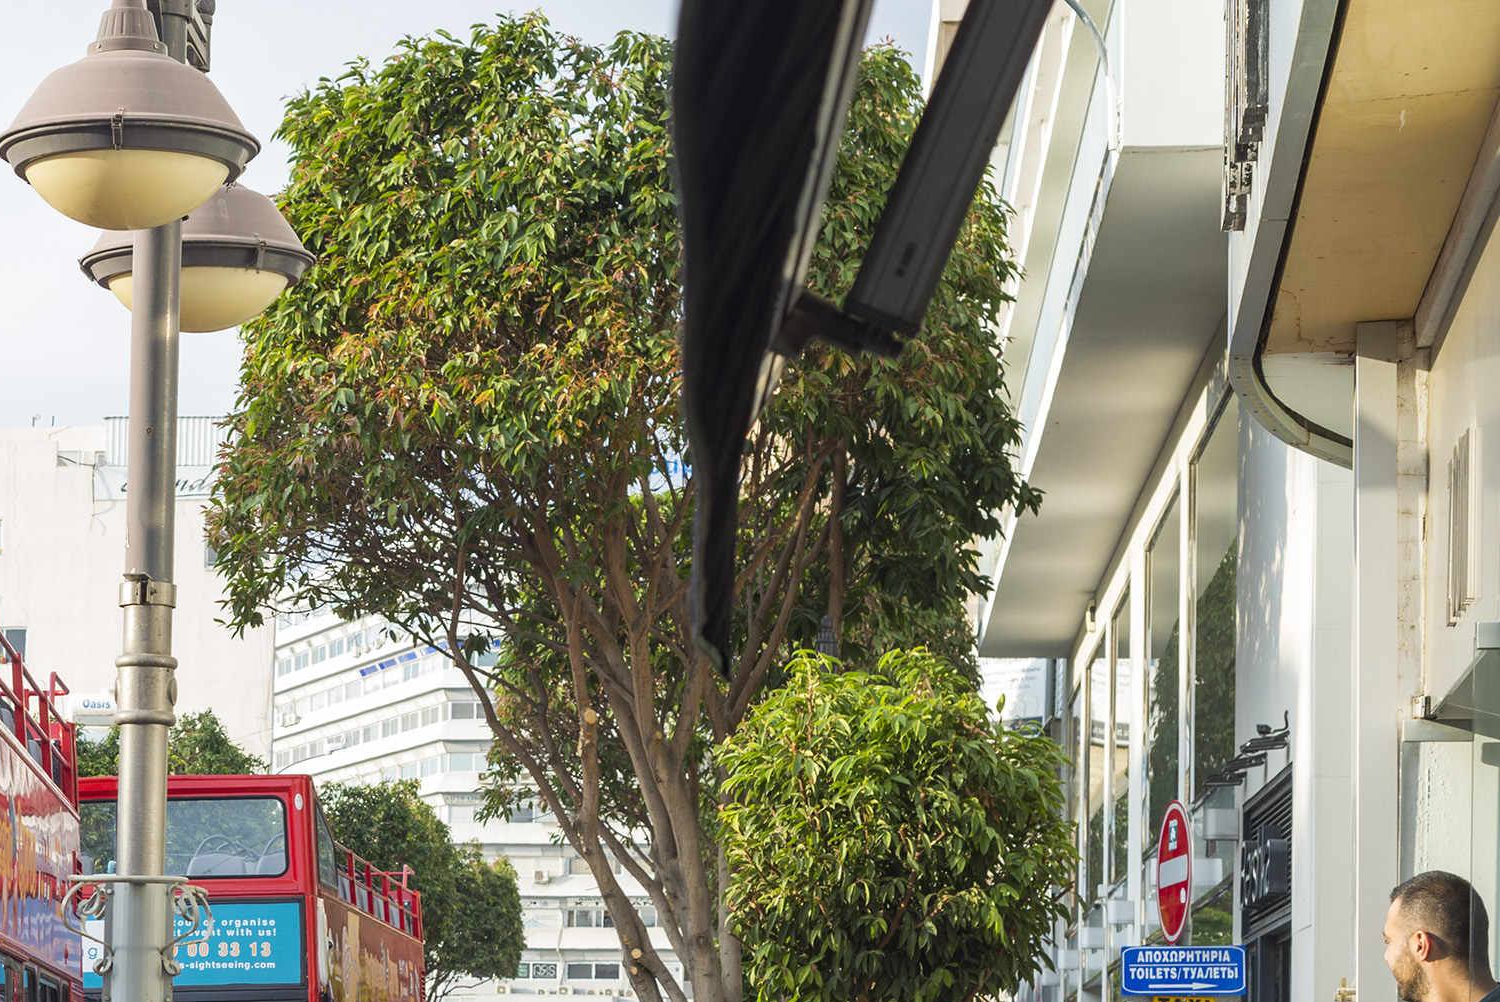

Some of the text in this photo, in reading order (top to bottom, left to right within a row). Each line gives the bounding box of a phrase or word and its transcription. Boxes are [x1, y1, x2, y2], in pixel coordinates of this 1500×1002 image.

[82, 699, 111, 709] Oasis
[221, 918, 276, 928] organise
[226, 928, 252, 936] with
[258, 928, 277, 936] us!
[187, 942, 209, 957] 00
[218, 942, 240, 957] 33
[249, 942, 271, 957] 13
[1137, 950, 1231, 963] ΑΠΟΧΩΡΗΤΗΡΙΑ
